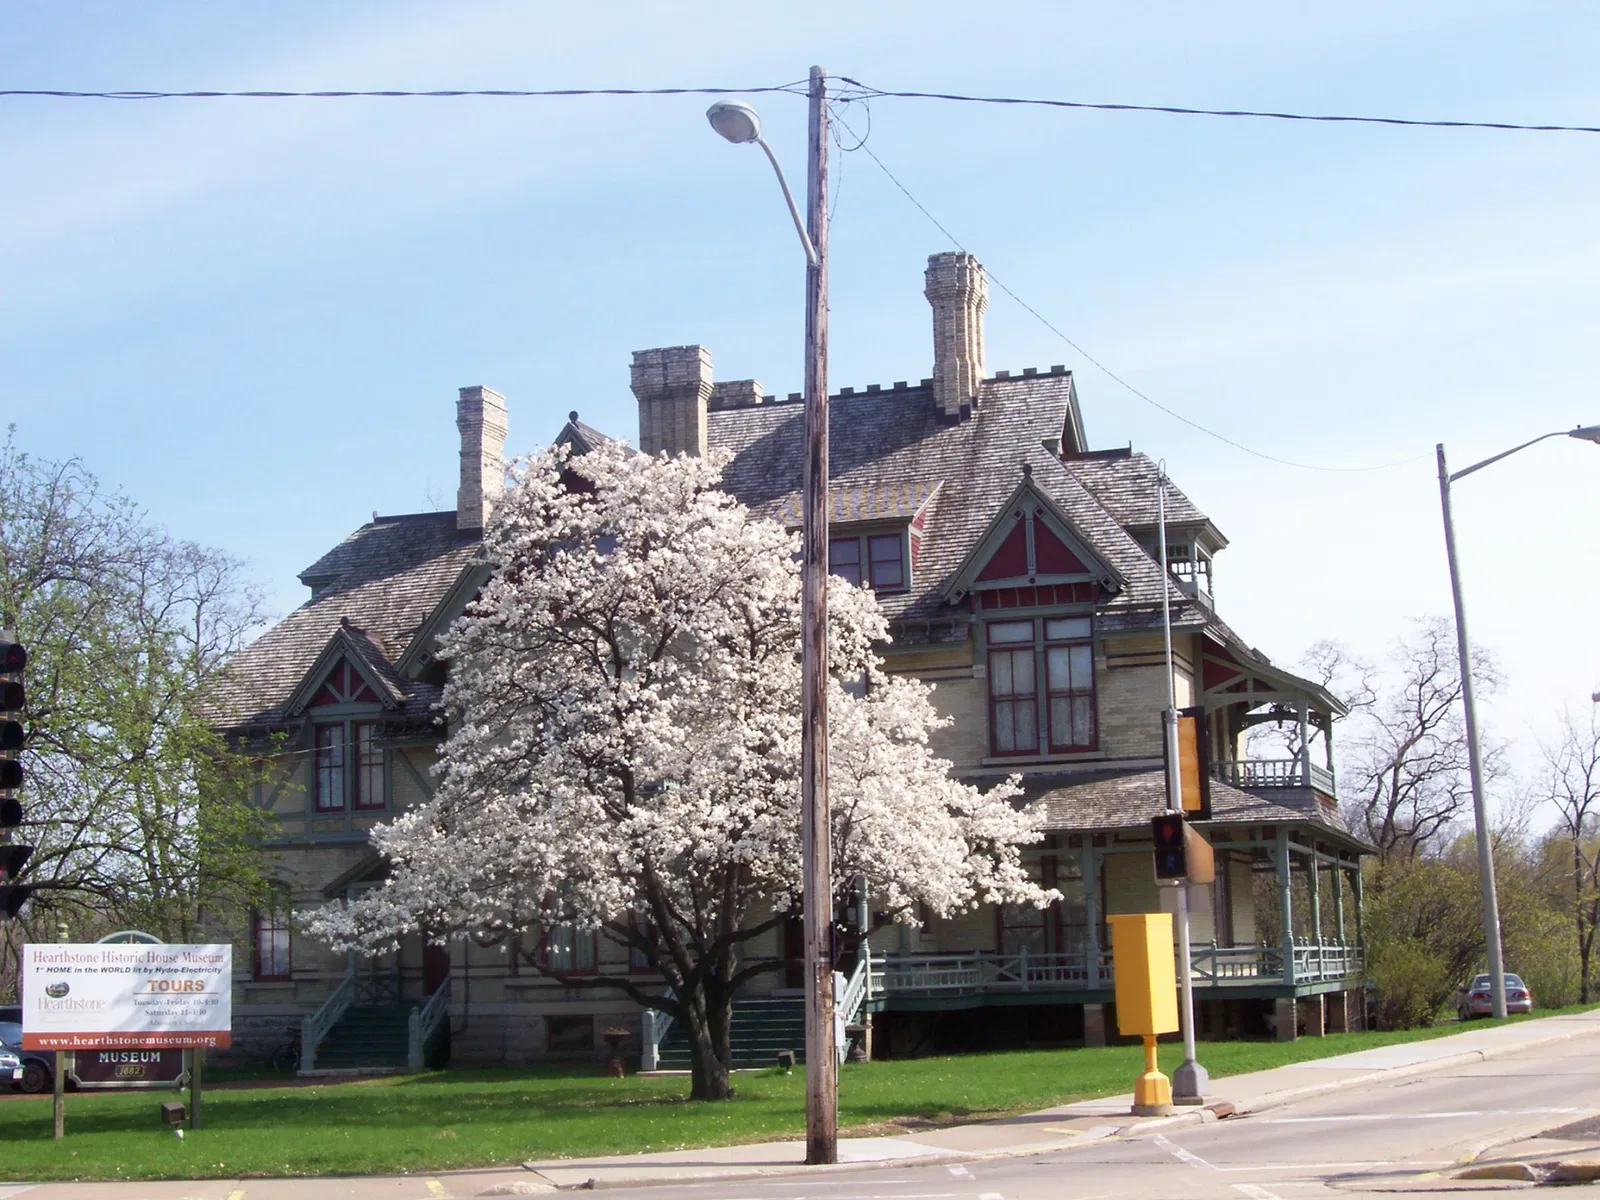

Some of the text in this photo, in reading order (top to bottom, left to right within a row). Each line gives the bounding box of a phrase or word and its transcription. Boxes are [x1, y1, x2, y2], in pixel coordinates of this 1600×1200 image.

[33, 951, 224, 963] Hearthstone Historic House Museum
[46, 966, 72, 974] HOME
[74, 966, 82, 974] in
[85, 966, 98, 974] the
[101, 966, 131, 974] WORLD
[133, 966, 141, 974] lit
[143, 966, 153, 975] by
[155, 966, 222, 975] Hydro-Electricity
[148, 980, 205, 992] TOURS
[38, 997, 105, 1010] Hearthstone
[39, 1035, 217, 1046] www.hearthstonemuseum.org
[99, 1052, 161, 1063] MUSEUM
